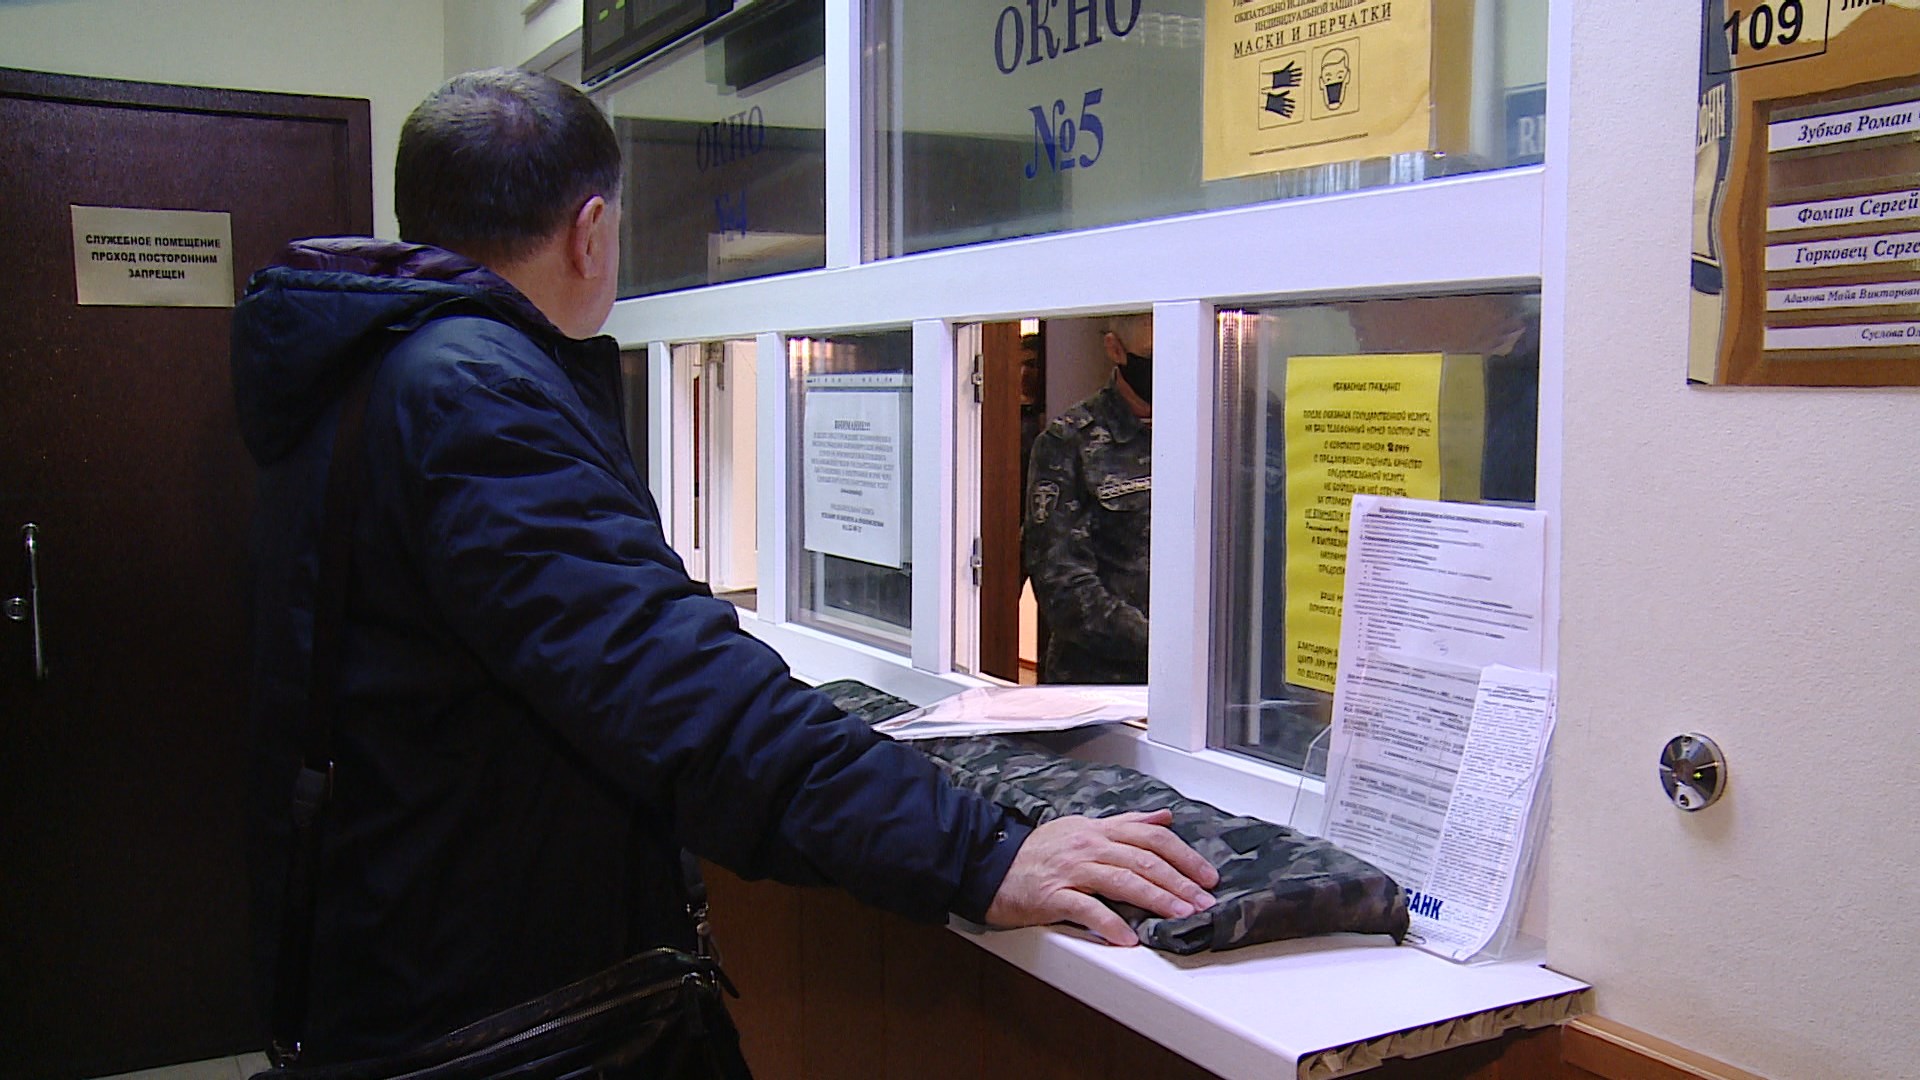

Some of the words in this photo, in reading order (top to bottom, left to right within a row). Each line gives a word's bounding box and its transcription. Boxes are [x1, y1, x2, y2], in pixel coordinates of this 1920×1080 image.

[994, 0, 1141, 75] ОКНО
[1233, 30, 1284, 56] МАСКИ
[1292, 26, 1301, 42] И
[1308, 2, 1392, 38] ПЕРЧАТКИ
[1723, 0, 1804, 55] 109
[696, 105, 765, 174] ОКНО
[1025, 88, 1104, 179] №5
[1798, 122, 1852, 144] Зубков
[1857, 110, 1913, 133] Роман
[1797, 204, 1854, 224] Фомин
[1859, 192, 1919, 217] Сергей
[85, 234, 151, 246] СЛУЖЕБНОЕ
[154, 236, 221, 249] ПОМЕЩЕНИЕ
[91, 251, 137, 264] ПРОХОД
[138, 253, 218, 264] ПОСТОРОННИМ
[1795, 245, 1868, 265] Горковец
[128, 268, 185, 280] ЗАПРЕЩЕН
[1783, 292, 1826, 304] Адамова
[1827, 289, 1857, 302] Майя
[1861, 328, 1904, 341] Суслова
